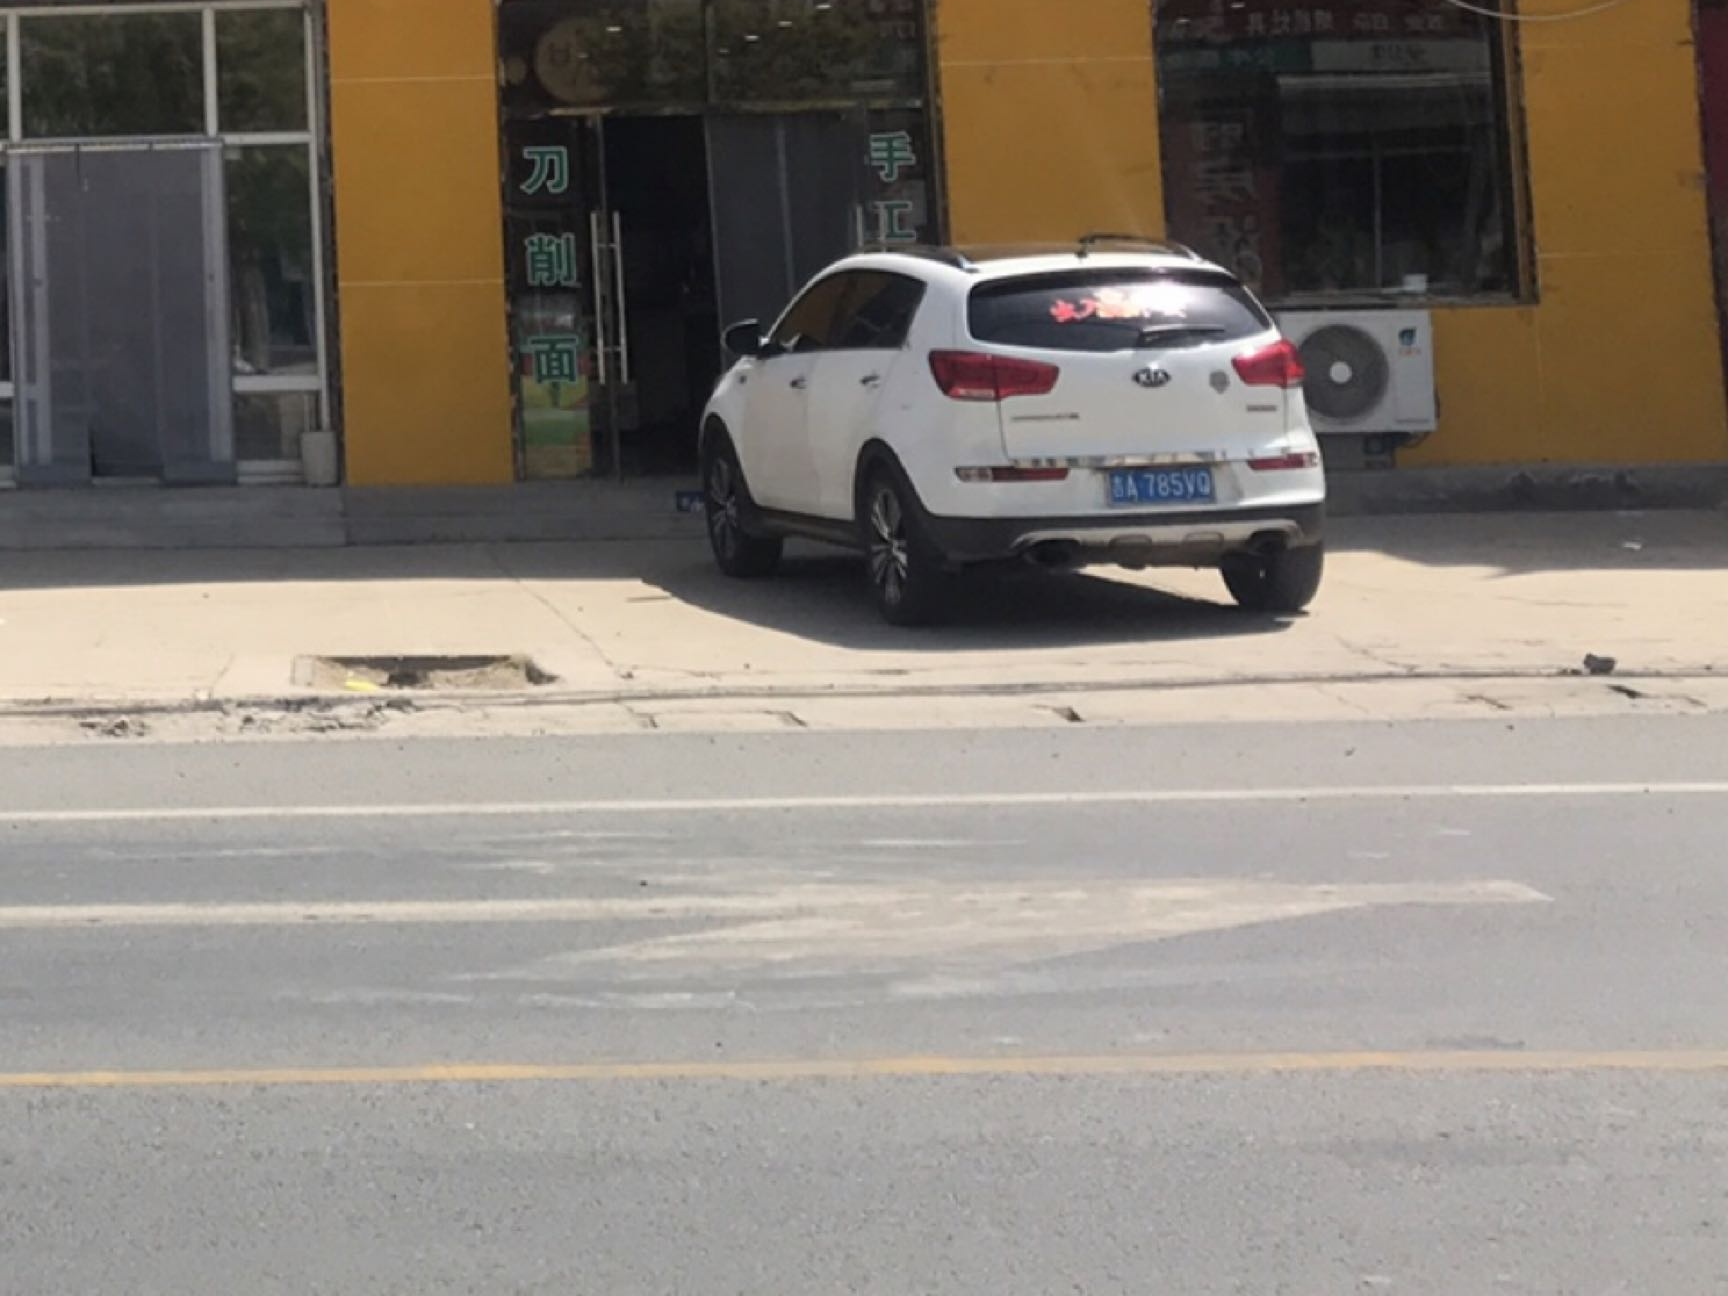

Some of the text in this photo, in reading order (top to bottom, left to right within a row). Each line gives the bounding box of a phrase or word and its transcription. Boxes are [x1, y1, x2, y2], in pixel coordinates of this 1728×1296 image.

[520, 145, 580, 385] 刀削面
[868, 131, 917, 243] 手工
